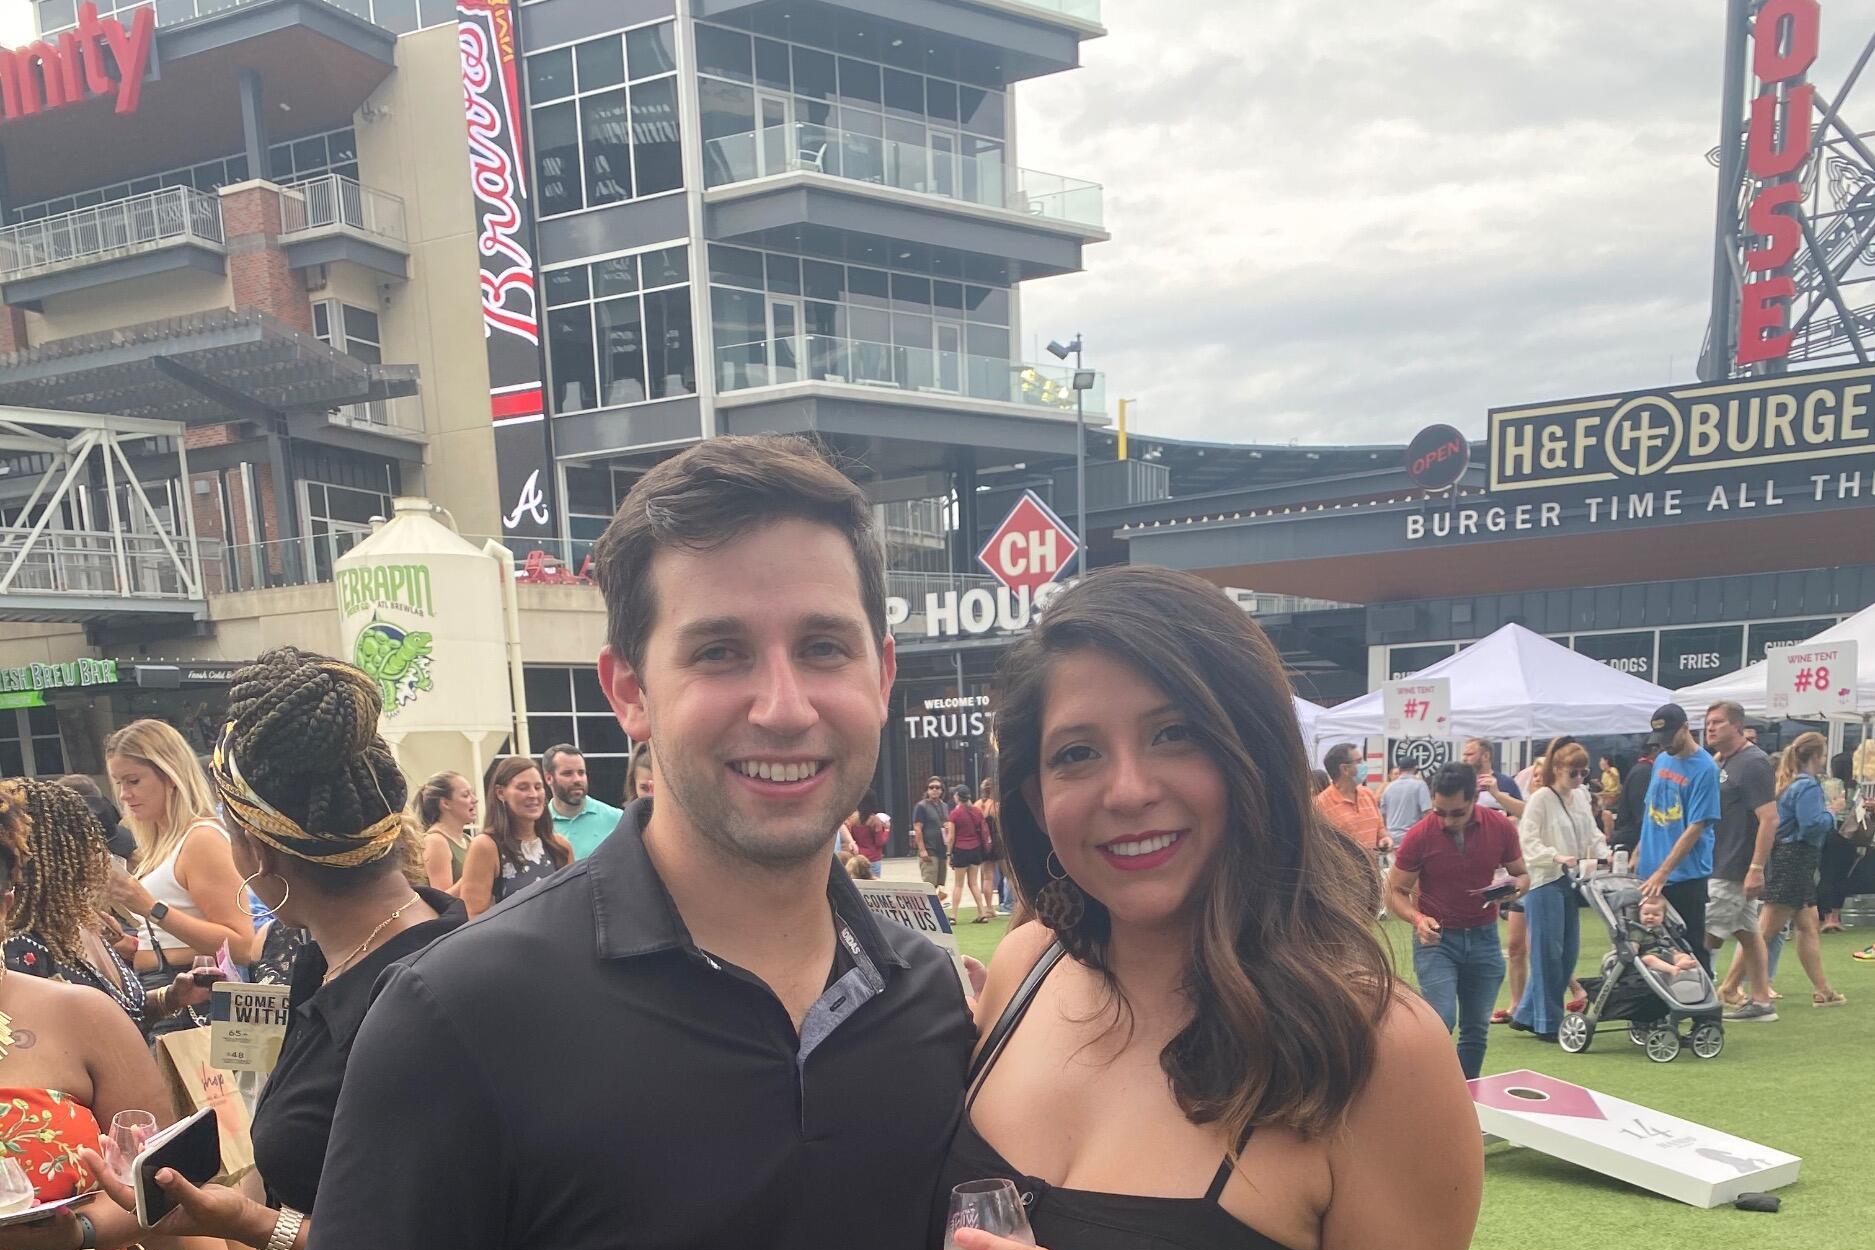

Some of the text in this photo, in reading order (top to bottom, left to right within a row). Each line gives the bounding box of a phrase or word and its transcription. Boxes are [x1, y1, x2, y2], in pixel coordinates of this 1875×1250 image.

[457, 21, 539, 346] Braves
[1504, 415, 1600, 477] H&F
[1688, 384, 1873, 457] BURGE
[1409, 438, 1461, 478] OPEN
[1405, 470, 1875, 540] BURGER TIME ALL TH
[999, 528, 1057, 576] CH
[336, 564, 434, 617] TERRAPIN
[1610, 656, 1648, 673] DOGS
[1679, 652, 1720, 670] FRIES
[1788, 650, 1838, 664] WINE TENT
[0, 658, 115, 691] ESH BREW BAR
[1794, 666, 1830, 693] #8
[1417, 685, 1435, 694] TENT
[924, 695, 990, 710] WELCOME TO
[1403, 698, 1430, 721] #7
[863, 894, 930, 911] COME CHILL
[912, 911, 937, 932] US
[234, 994, 276, 1009] COME
[235, 1007, 287, 1026] WITH
